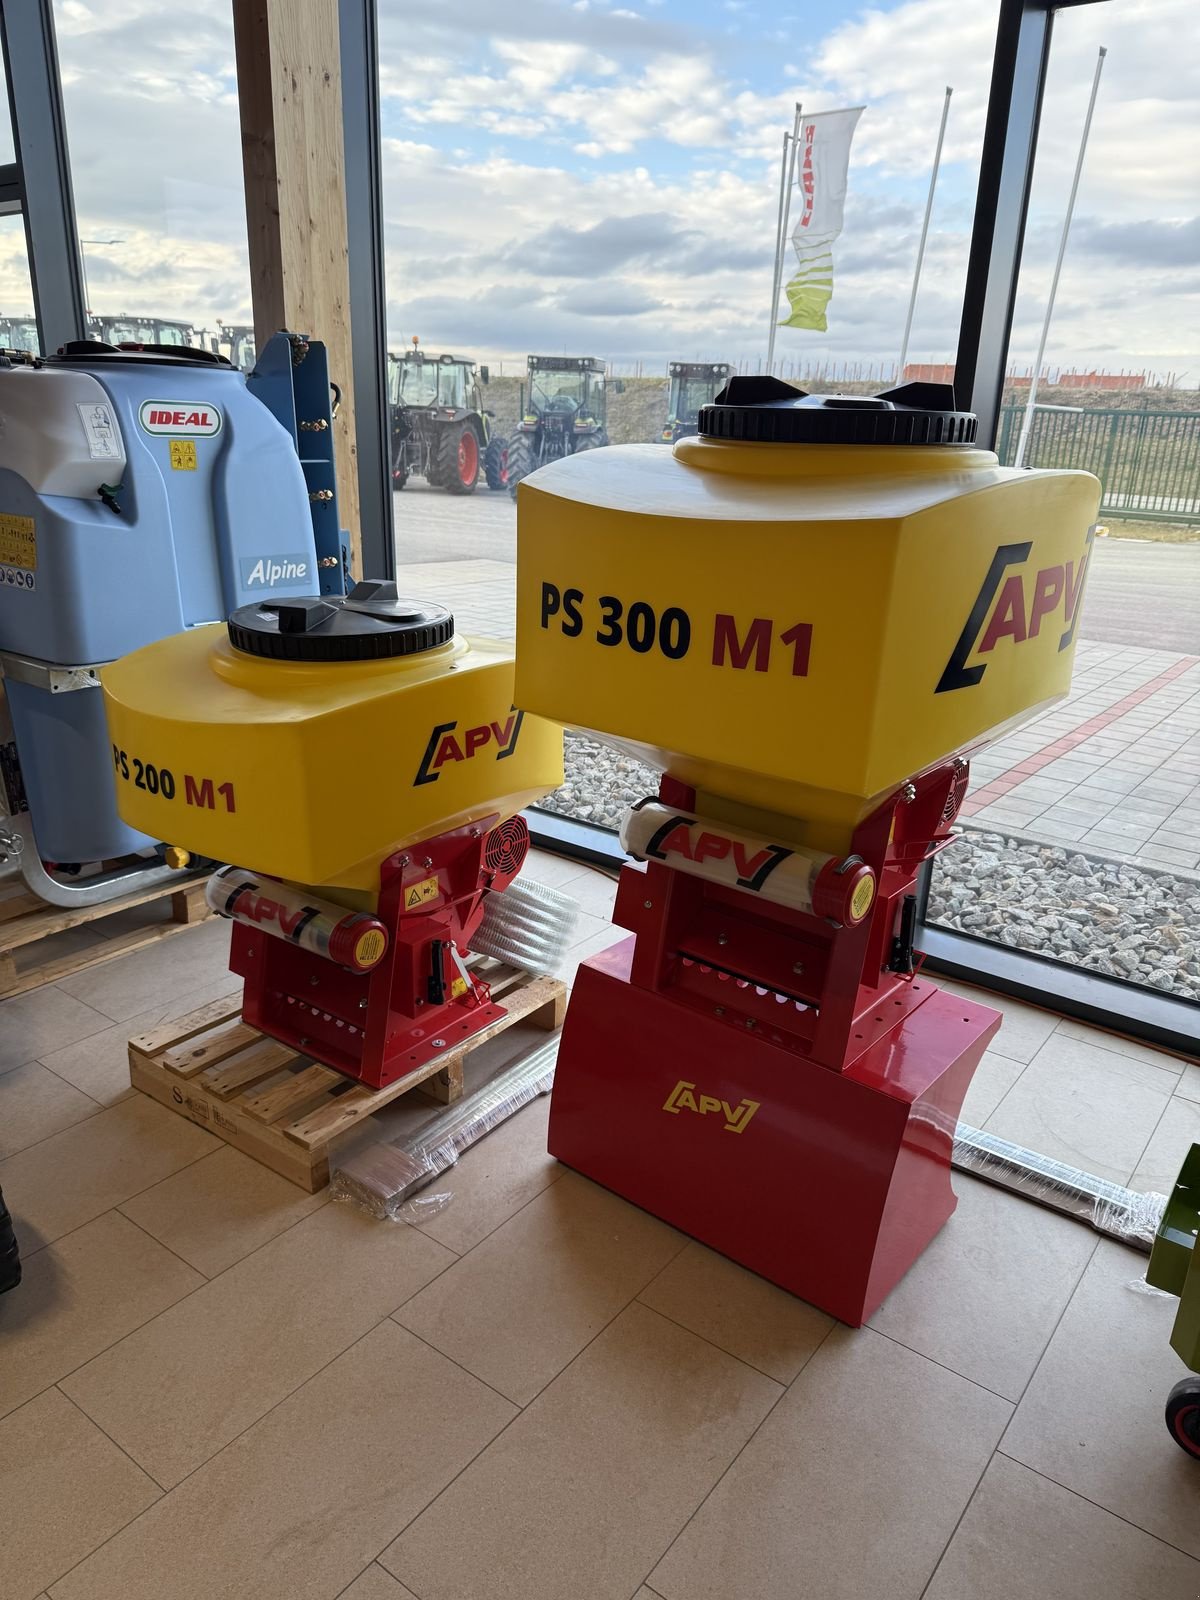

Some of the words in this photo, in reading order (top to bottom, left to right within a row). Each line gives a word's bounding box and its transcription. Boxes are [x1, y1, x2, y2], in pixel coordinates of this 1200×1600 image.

[149, 410, 213, 426] IDEAL
[247, 559, 307, 586] Alpine
[541, 581, 584, 638] PS
[596, 596, 691, 660] 300
[712, 613, 813, 677] M1
[976, 554, 1088, 654] APV
[432, 715, 516, 769] APV
[112, 743, 130, 780] PS
[132, 758, 176, 800] 200
[184, 774, 236, 813] M1
[659, 824, 772, 879] APV
[232, 889, 305, 936] APV
[675, 1089, 747, 1124] APV
